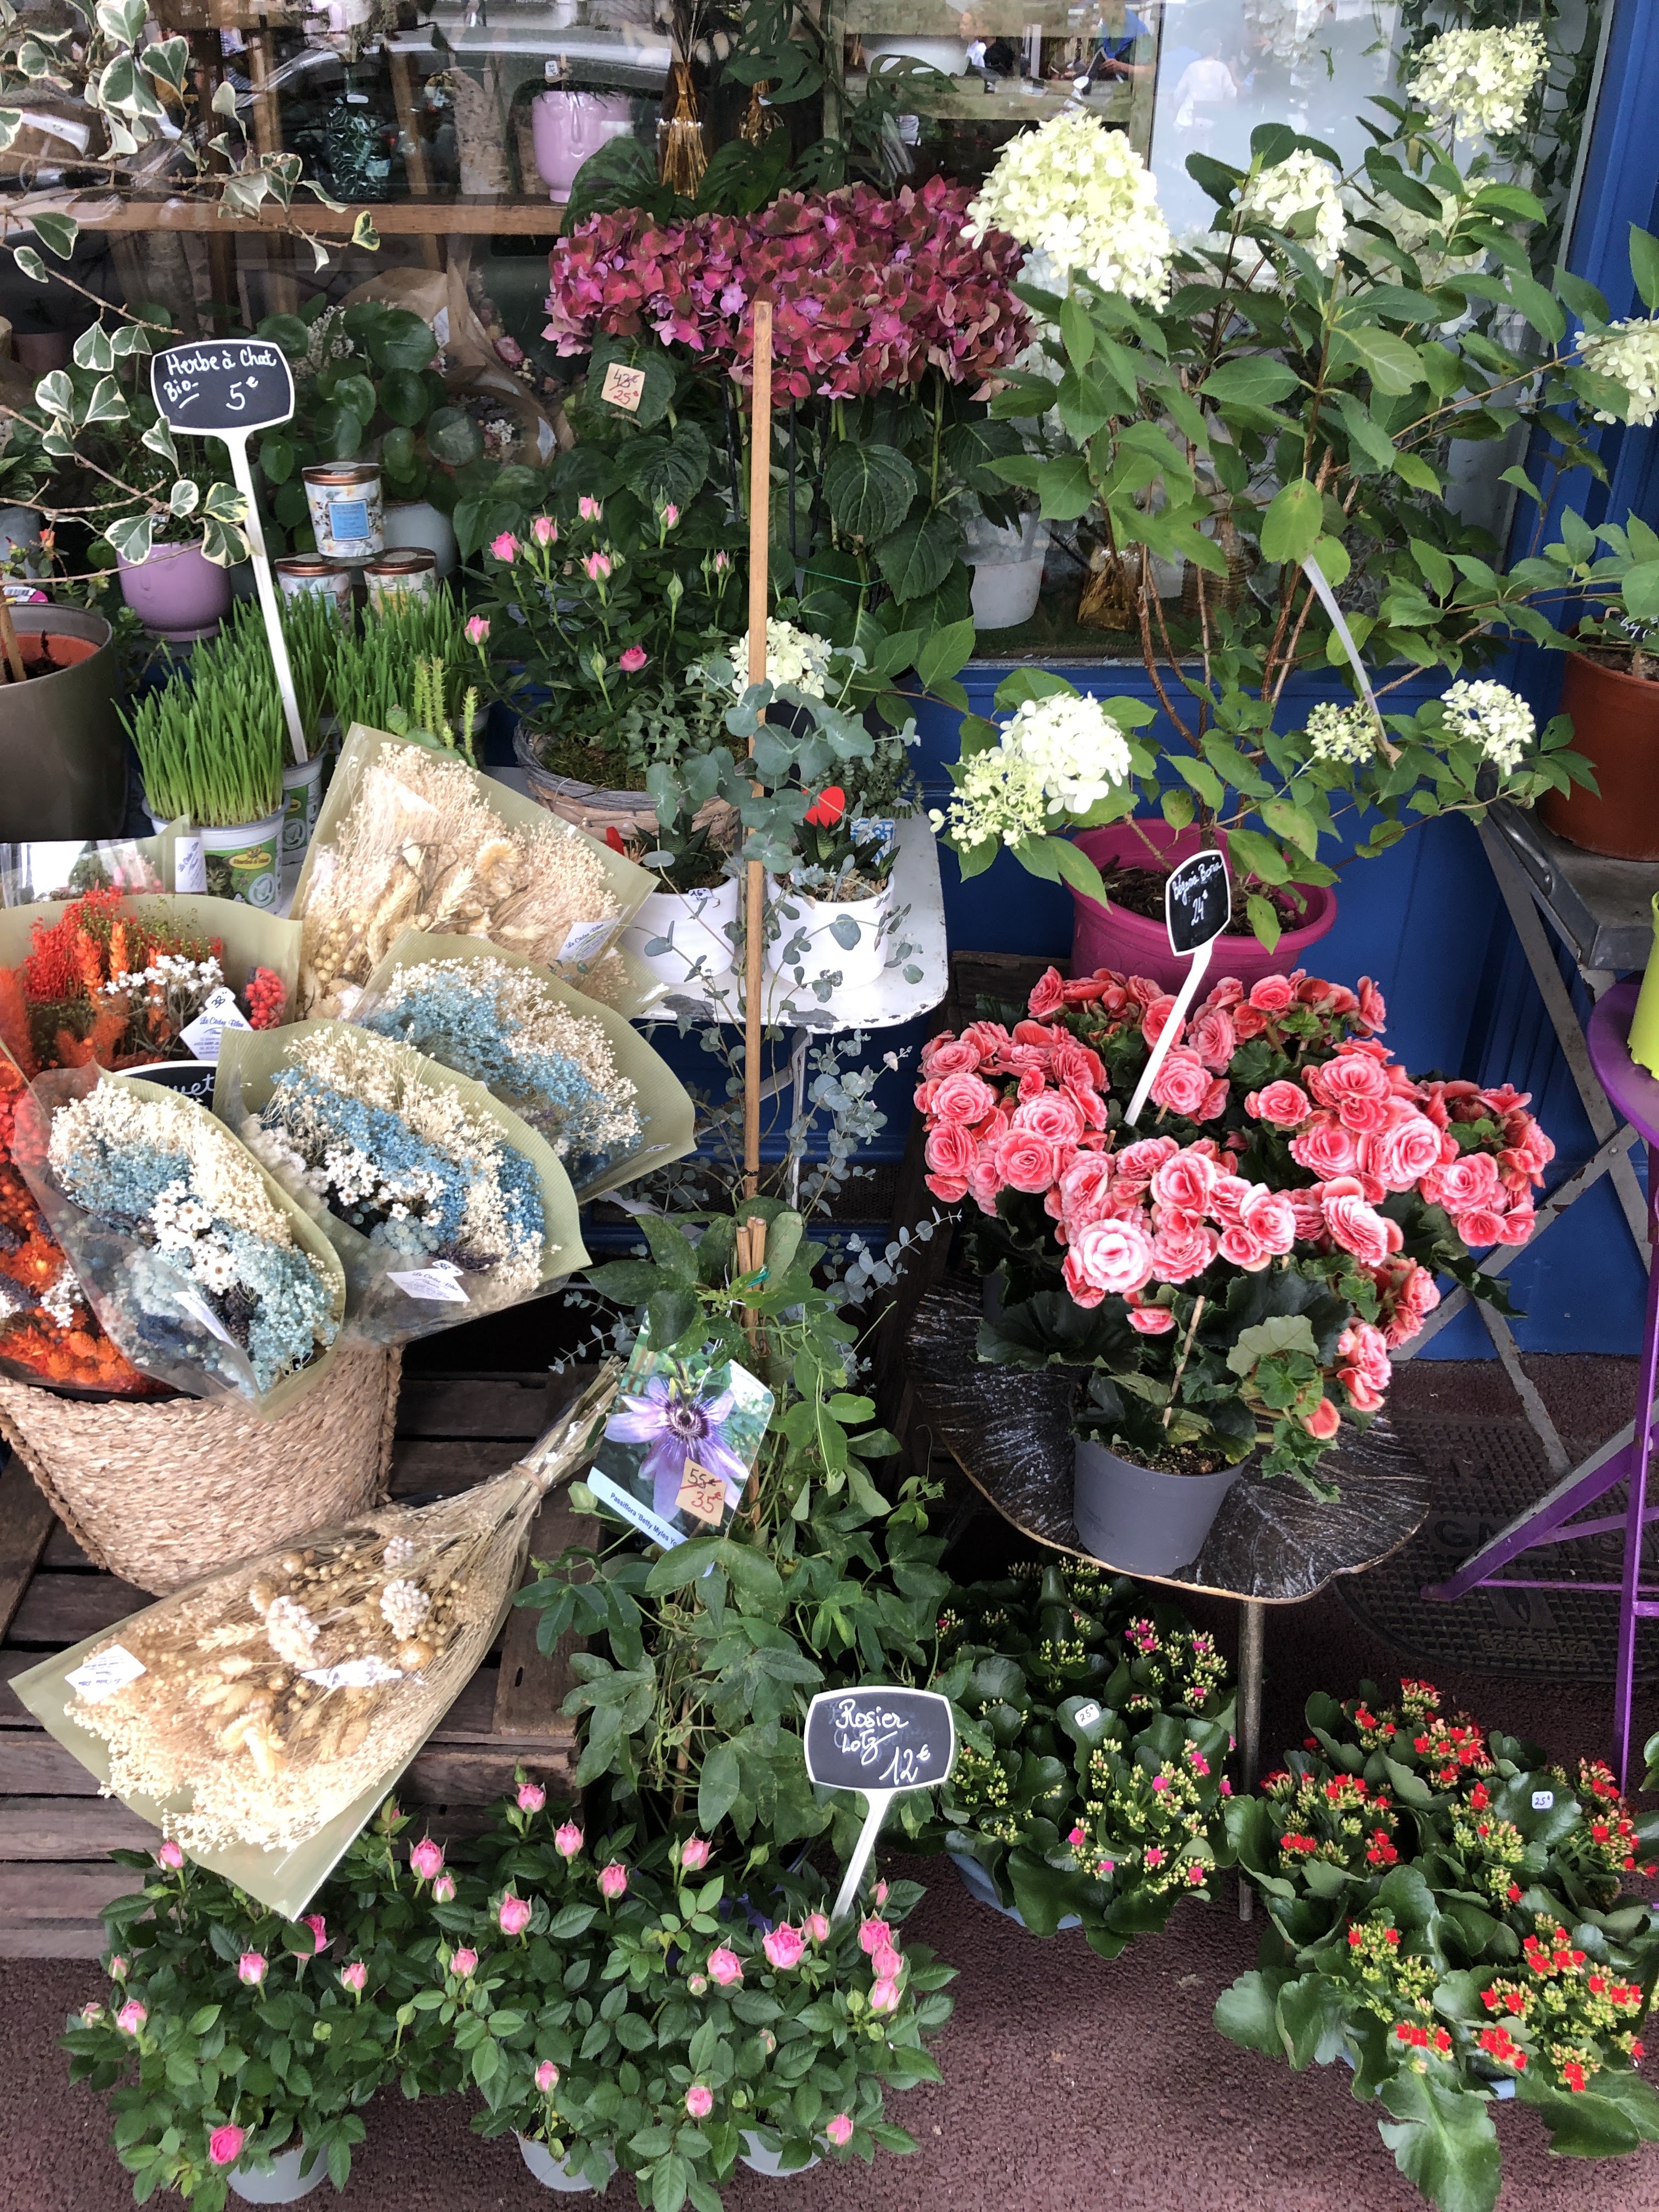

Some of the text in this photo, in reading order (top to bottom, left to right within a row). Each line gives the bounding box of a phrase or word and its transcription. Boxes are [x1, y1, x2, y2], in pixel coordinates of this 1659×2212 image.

[166, 346, 277, 375] Herbe à Chat
[610, 1492, 636, 1516] Passiflora
[653, 1525, 669, 1541] Myles
[836, 1699, 909, 1728] Rosier
